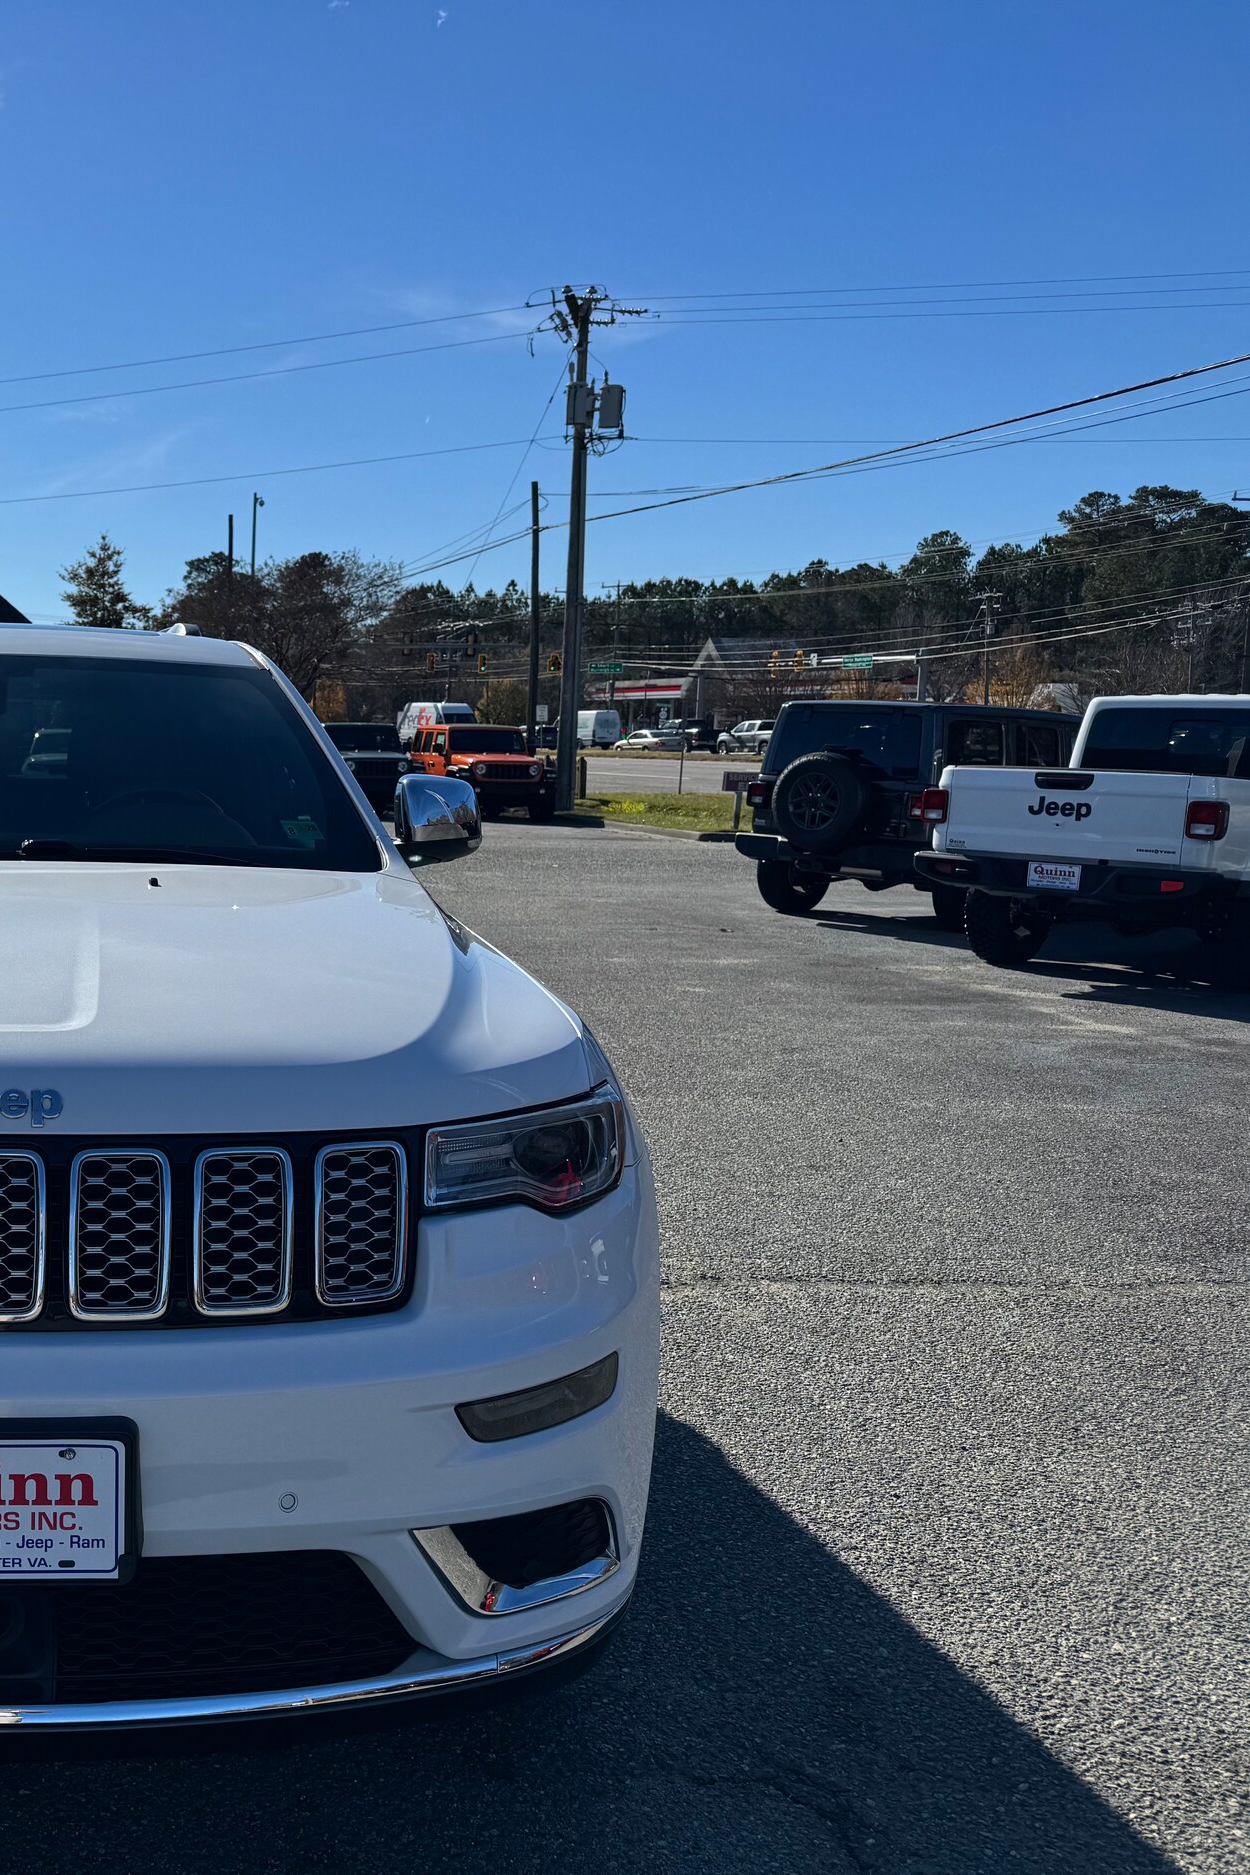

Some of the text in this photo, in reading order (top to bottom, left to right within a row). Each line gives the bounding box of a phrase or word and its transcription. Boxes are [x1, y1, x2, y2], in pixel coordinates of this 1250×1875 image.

[1028, 796, 1092, 821] Jeep
[1033, 865, 1076, 878] Quinn
[30, 1511, 83, 1531] INC.
[16, 1534, 54, 1553] Jeep
[69, 1534, 106, 1549] Ram
[27, 1557, 52, 1568] VA.
